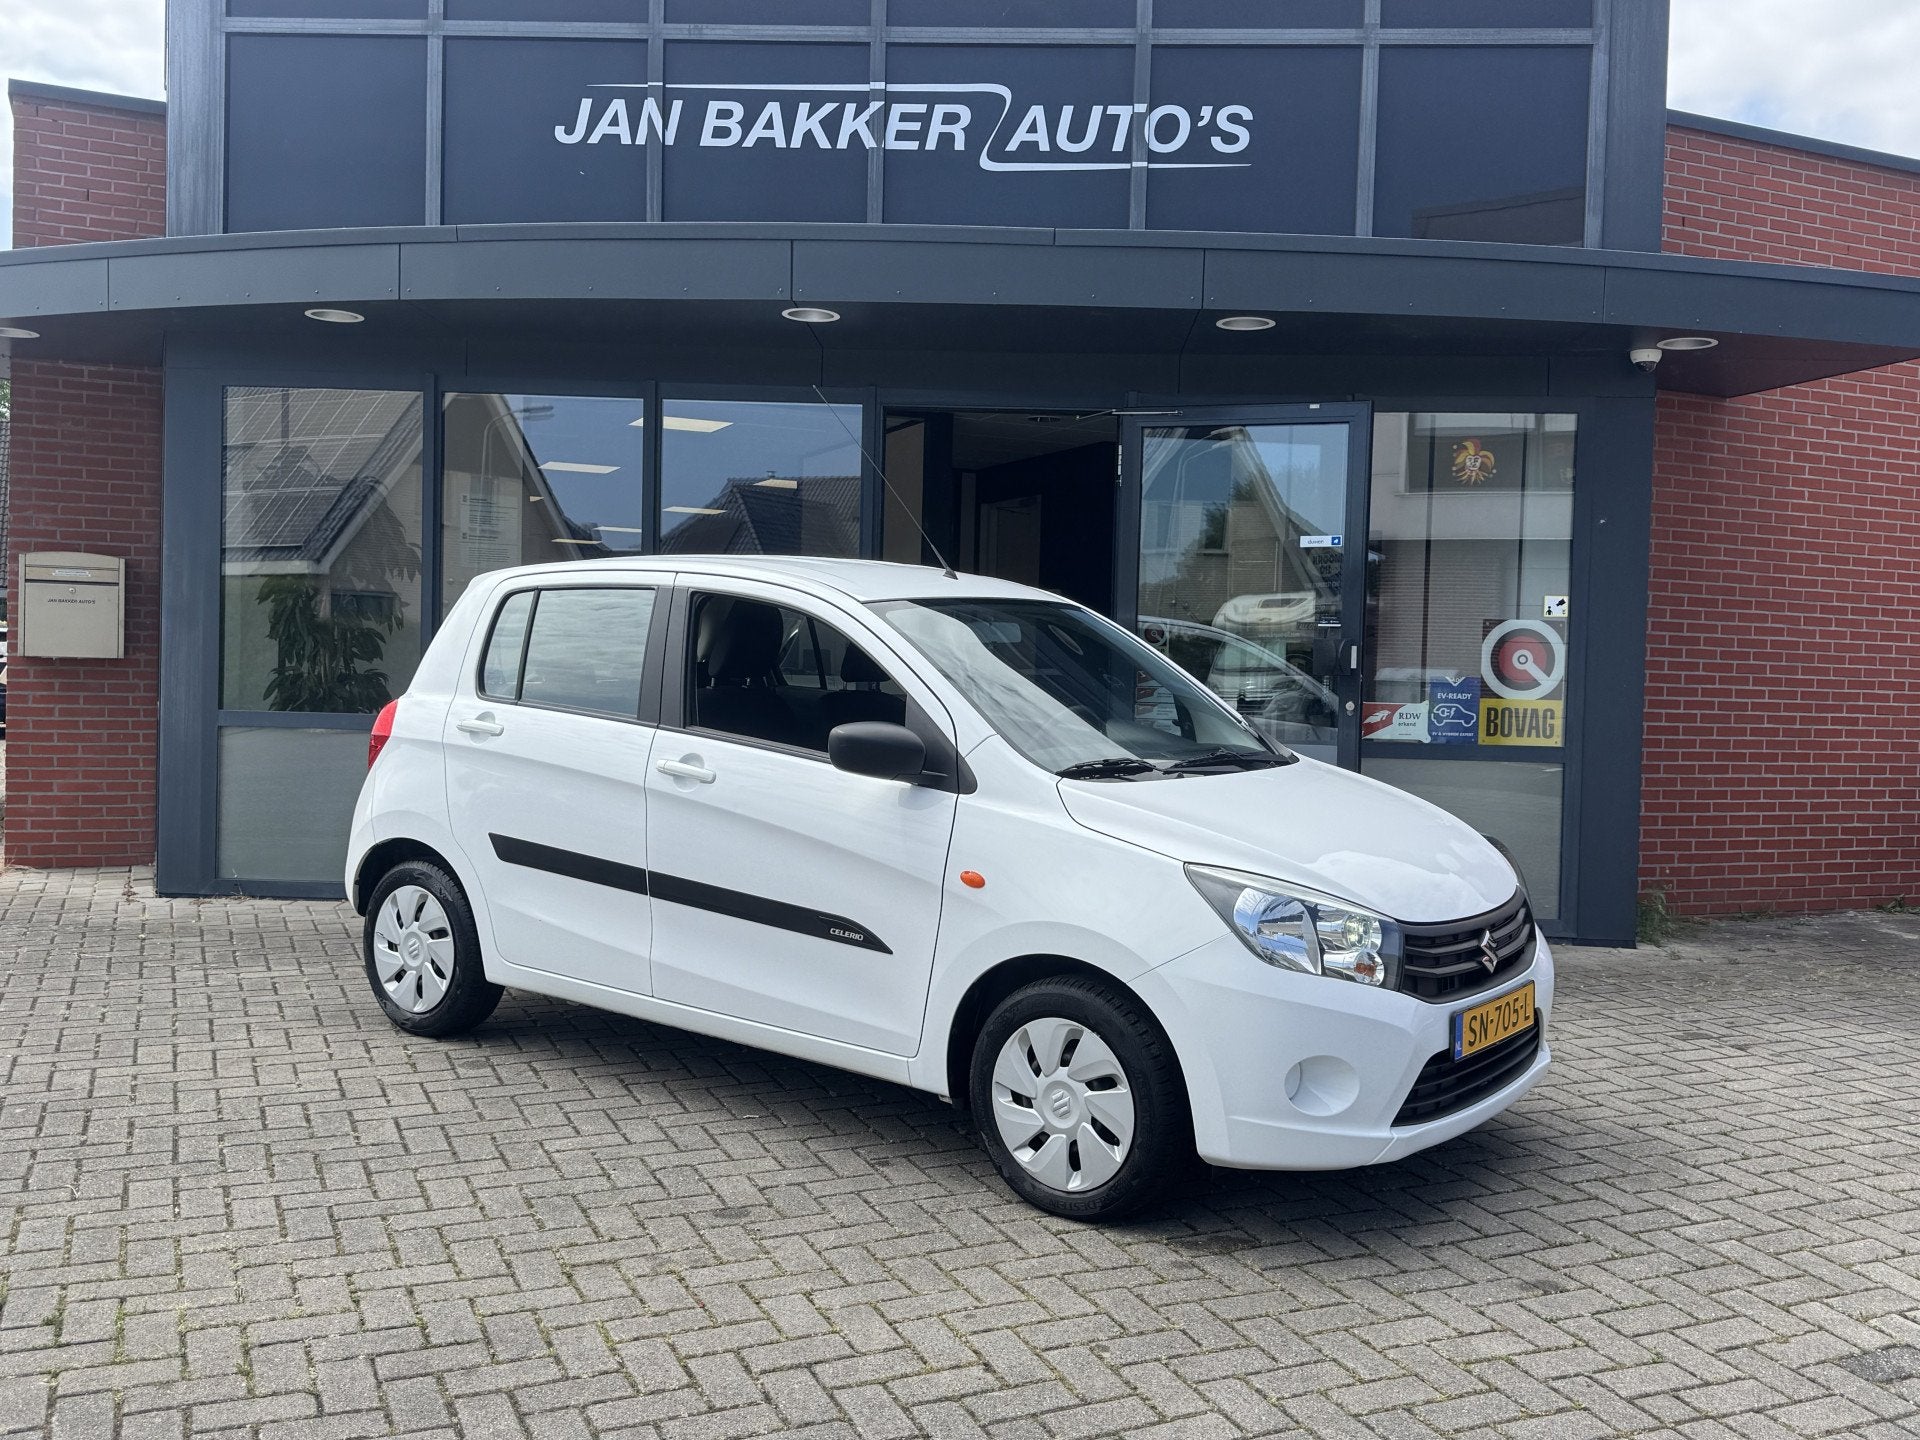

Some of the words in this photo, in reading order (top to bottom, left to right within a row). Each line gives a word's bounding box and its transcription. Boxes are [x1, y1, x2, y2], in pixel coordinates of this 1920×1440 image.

[554, 97, 683, 145] JAN
[700, 98, 972, 151] BAKKER
[1004, 103, 1254, 154] AUTO'S
[1398, 712, 1421, 720] RDW
[1485, 707, 1555, 739] BOVAG
[830, 927, 864, 941] CELERIO
[1468, 993, 1530, 1047] SN-705-L
